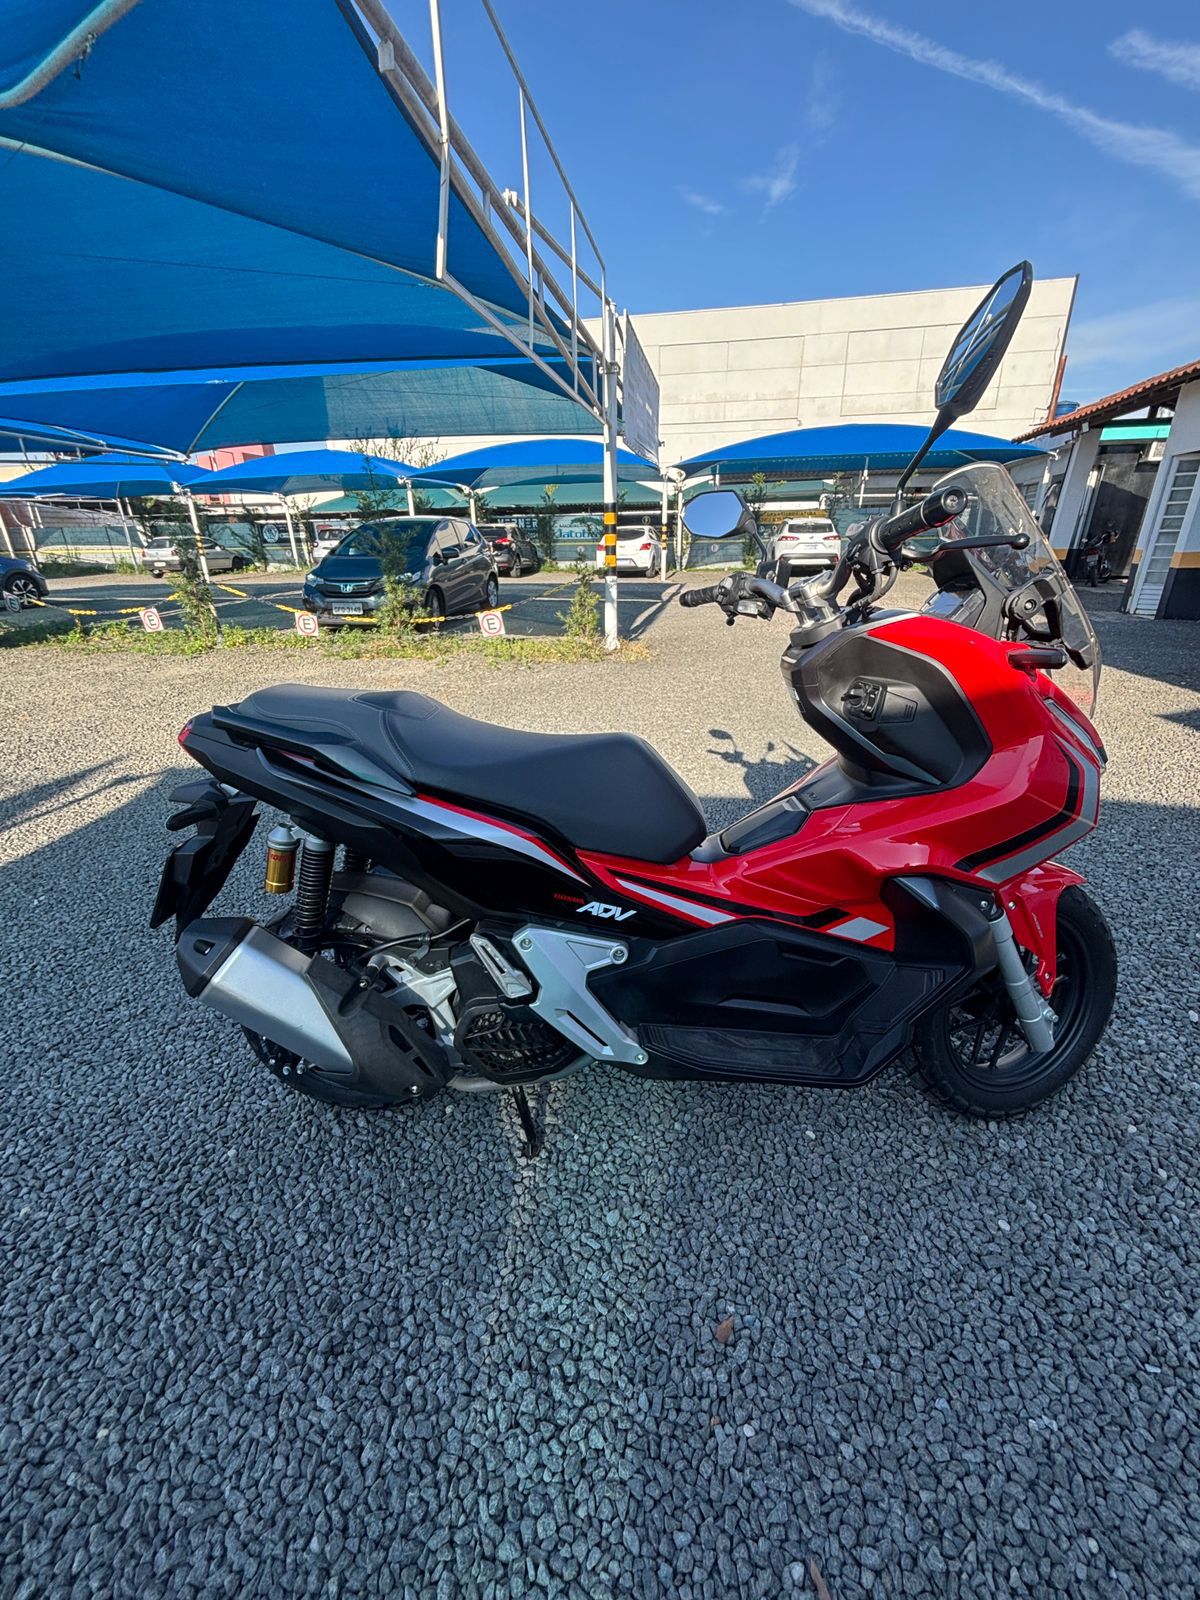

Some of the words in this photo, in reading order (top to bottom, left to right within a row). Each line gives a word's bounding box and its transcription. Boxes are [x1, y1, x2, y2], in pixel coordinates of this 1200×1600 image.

[147, 614, 156, 626] E
[302, 618, 312, 630] E
[486, 618, 497, 630] E
[553, 893, 585, 904] HONDA
[576, 901, 637, 921] ADV
